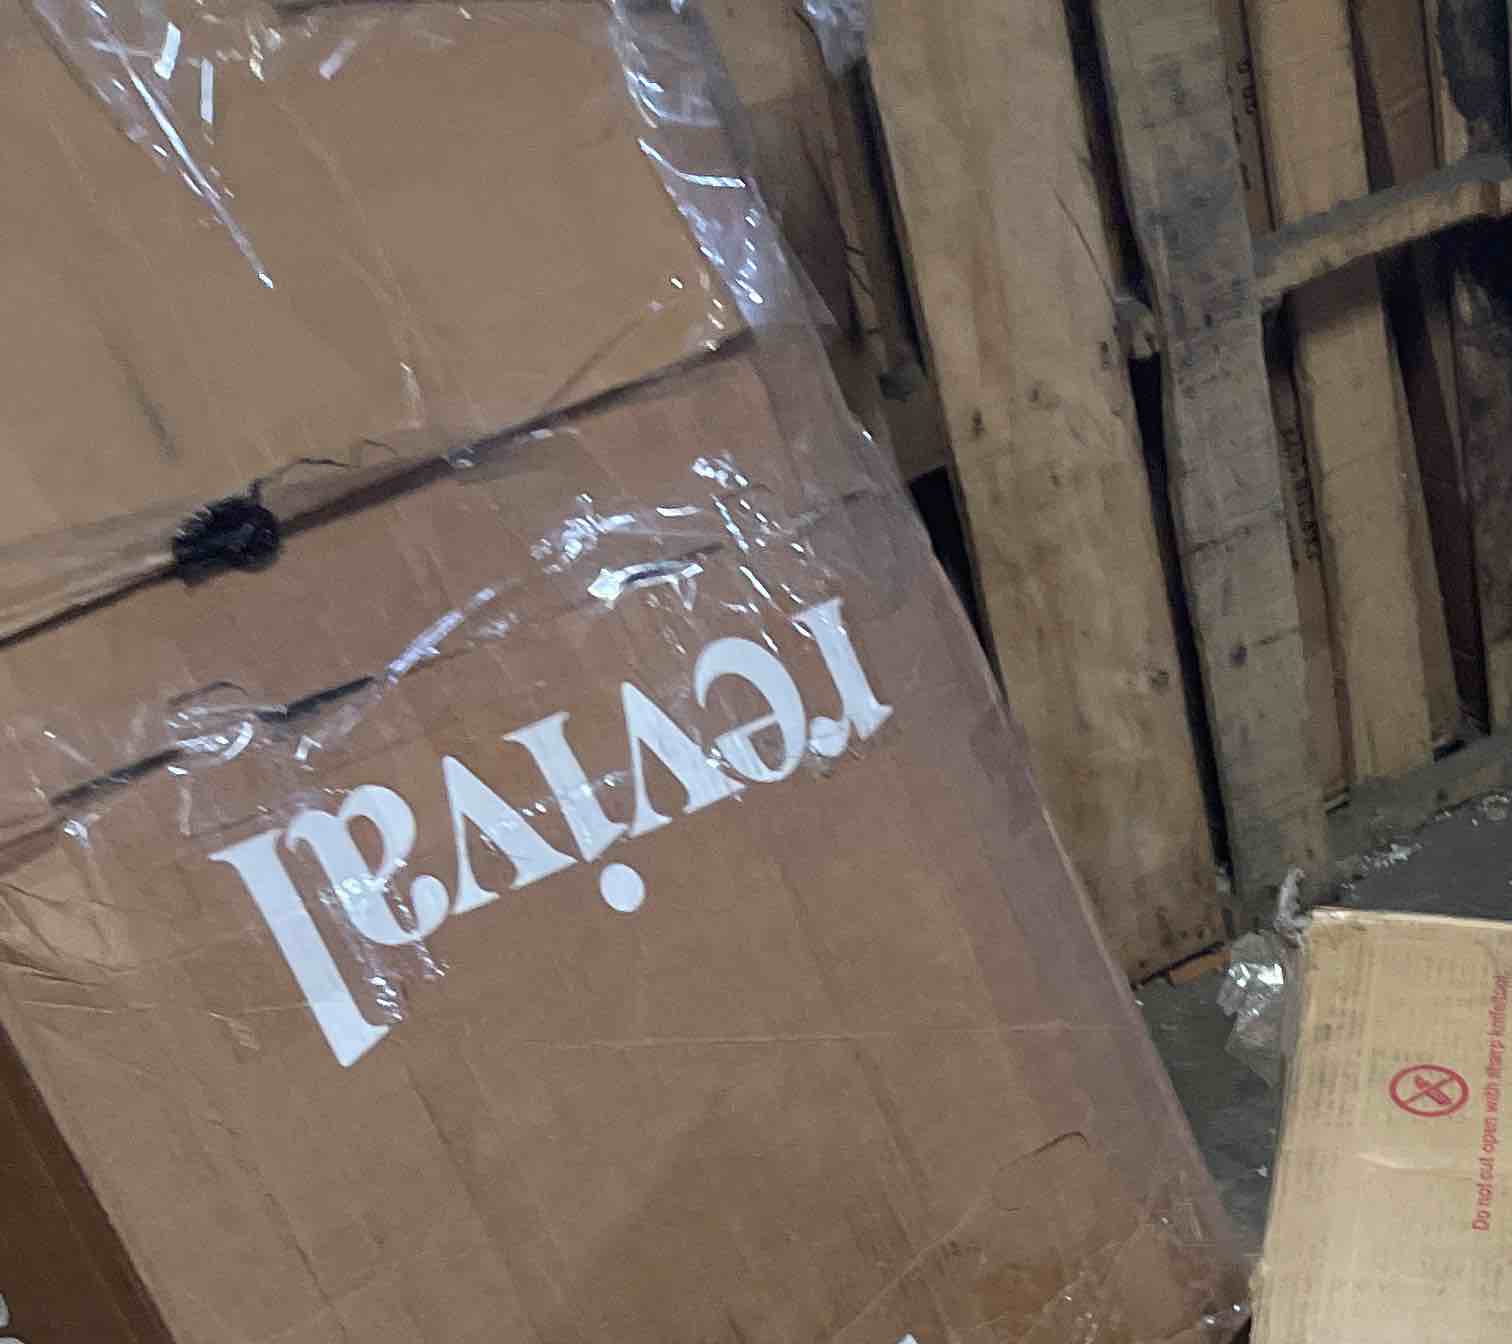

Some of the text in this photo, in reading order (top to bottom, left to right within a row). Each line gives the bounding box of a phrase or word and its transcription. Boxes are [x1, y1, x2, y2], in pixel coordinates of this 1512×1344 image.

[208, 596, 895, 1069] revival
[1483, 1081, 1500, 1113] with
[1481, 1119, 1499, 1153] open
[1477, 1157, 1494, 1181] cut
[1476, 1183, 1492, 1207] not
[1471, 1210, 1491, 1232] Do
